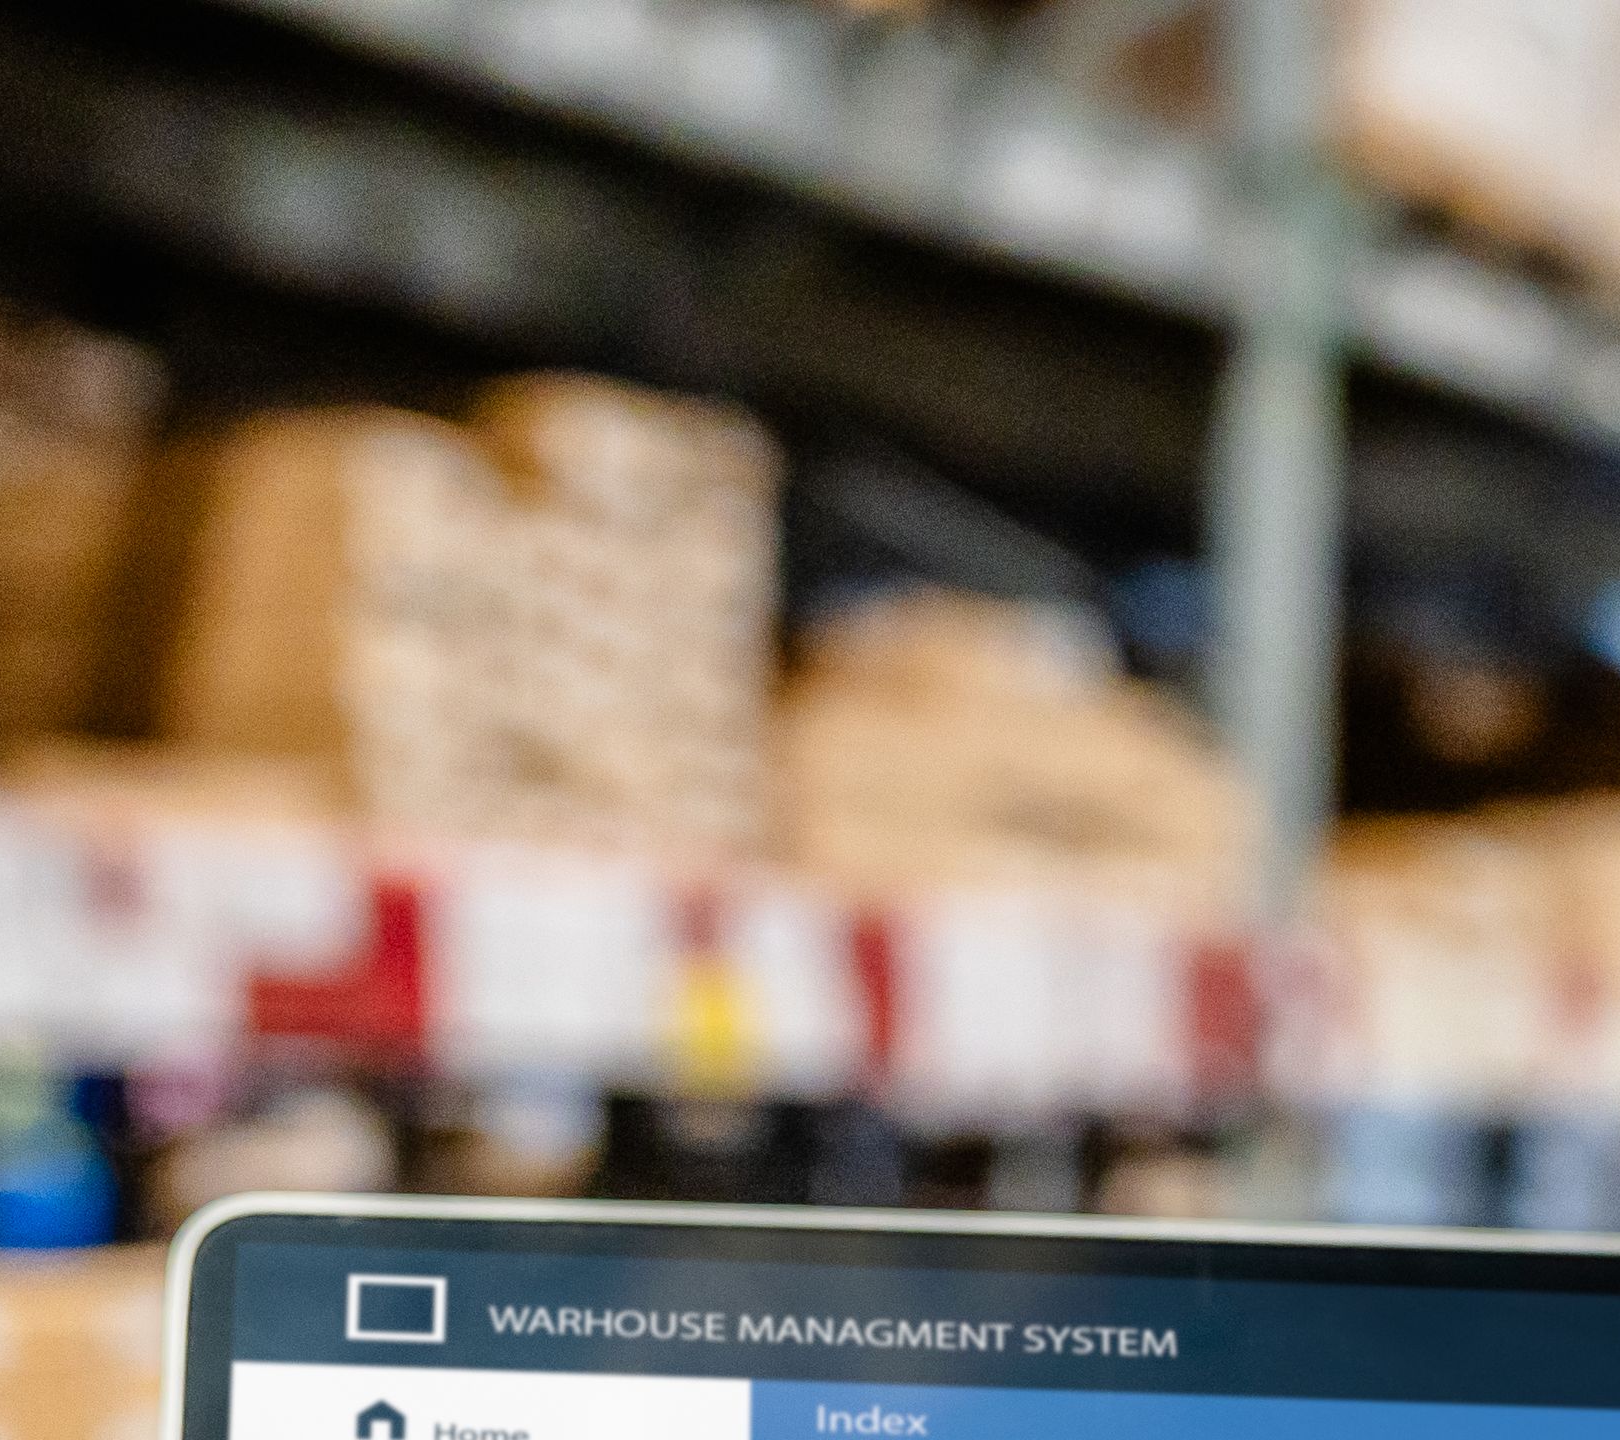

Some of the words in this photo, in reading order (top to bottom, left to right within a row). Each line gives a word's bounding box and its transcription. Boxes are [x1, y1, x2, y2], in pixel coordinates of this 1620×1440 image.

[489, 1306, 725, 1342] WARHOUSE
[738, 1314, 1011, 1350] MANAGMENT
[1024, 1325, 1178, 1359] SYSTEM
[817, 1405, 926, 1435] Index
